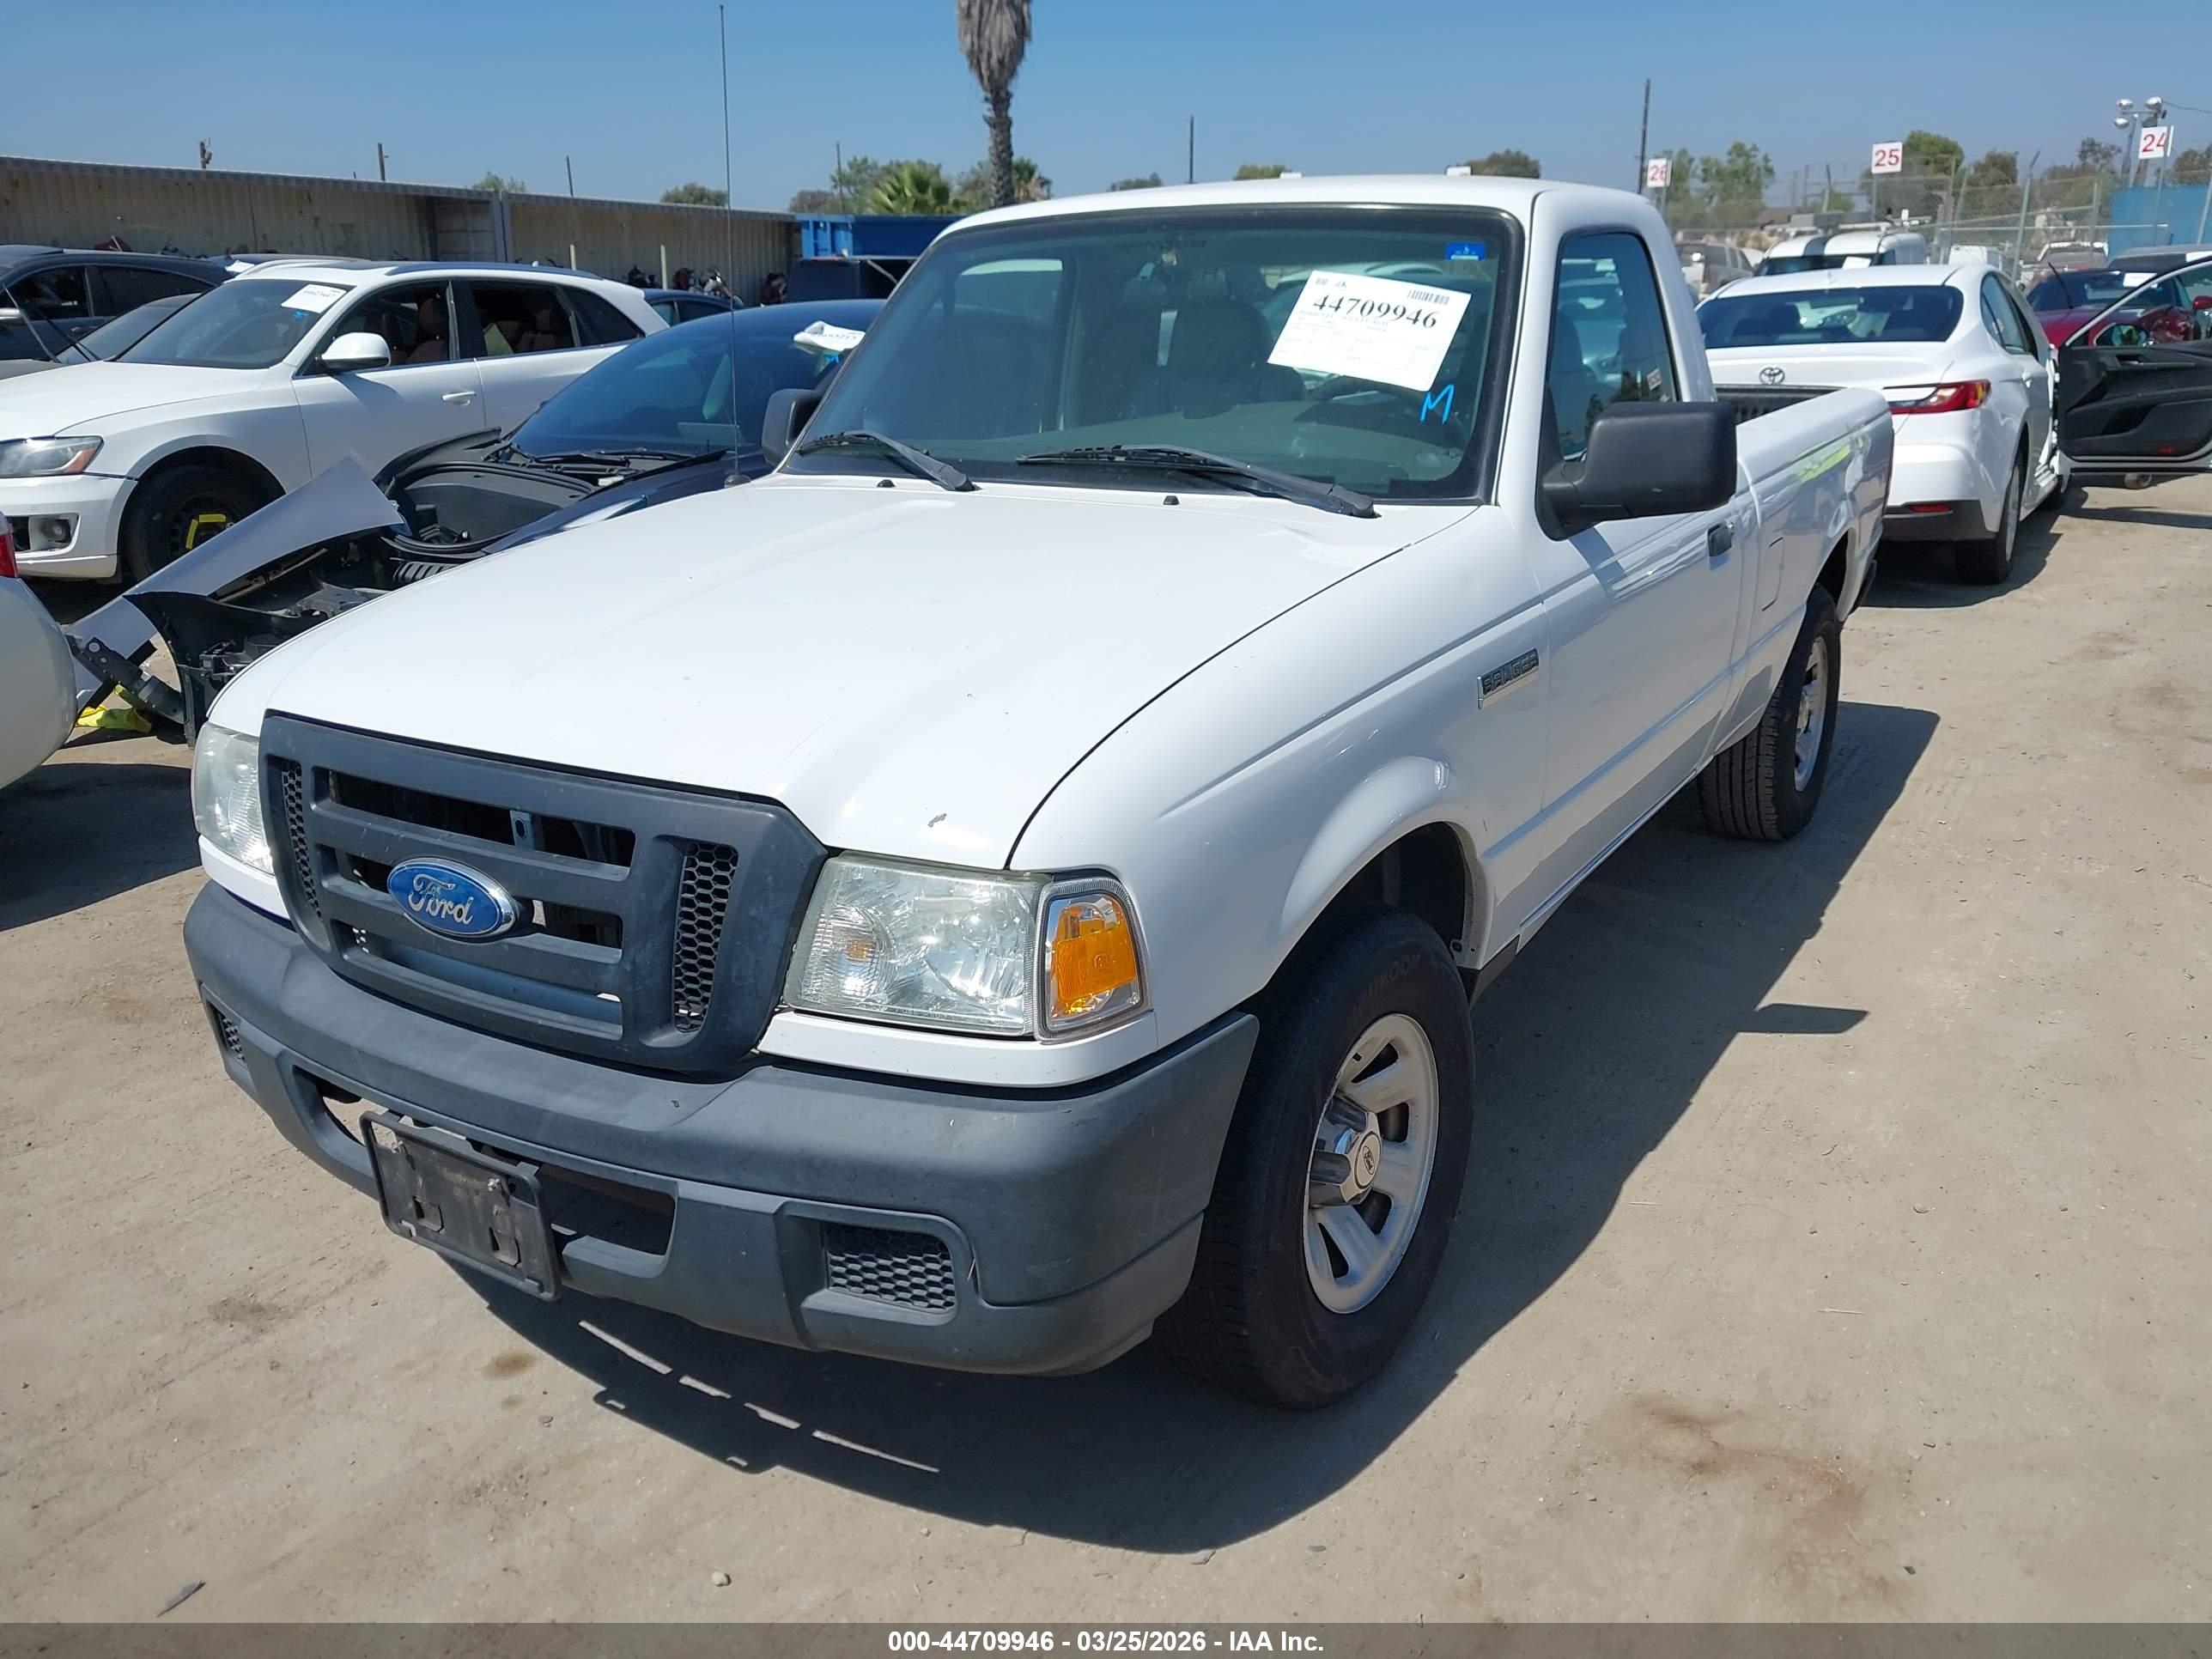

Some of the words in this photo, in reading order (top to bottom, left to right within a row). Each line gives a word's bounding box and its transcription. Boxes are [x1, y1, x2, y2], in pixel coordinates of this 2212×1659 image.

[1875, 148, 1899, 167] 25
[2142, 132, 2166, 153] 24
[1313, 295, 1440, 329] 44709946
[1419, 383, 1455, 425] M
[408, 872, 474, 925] Ford
